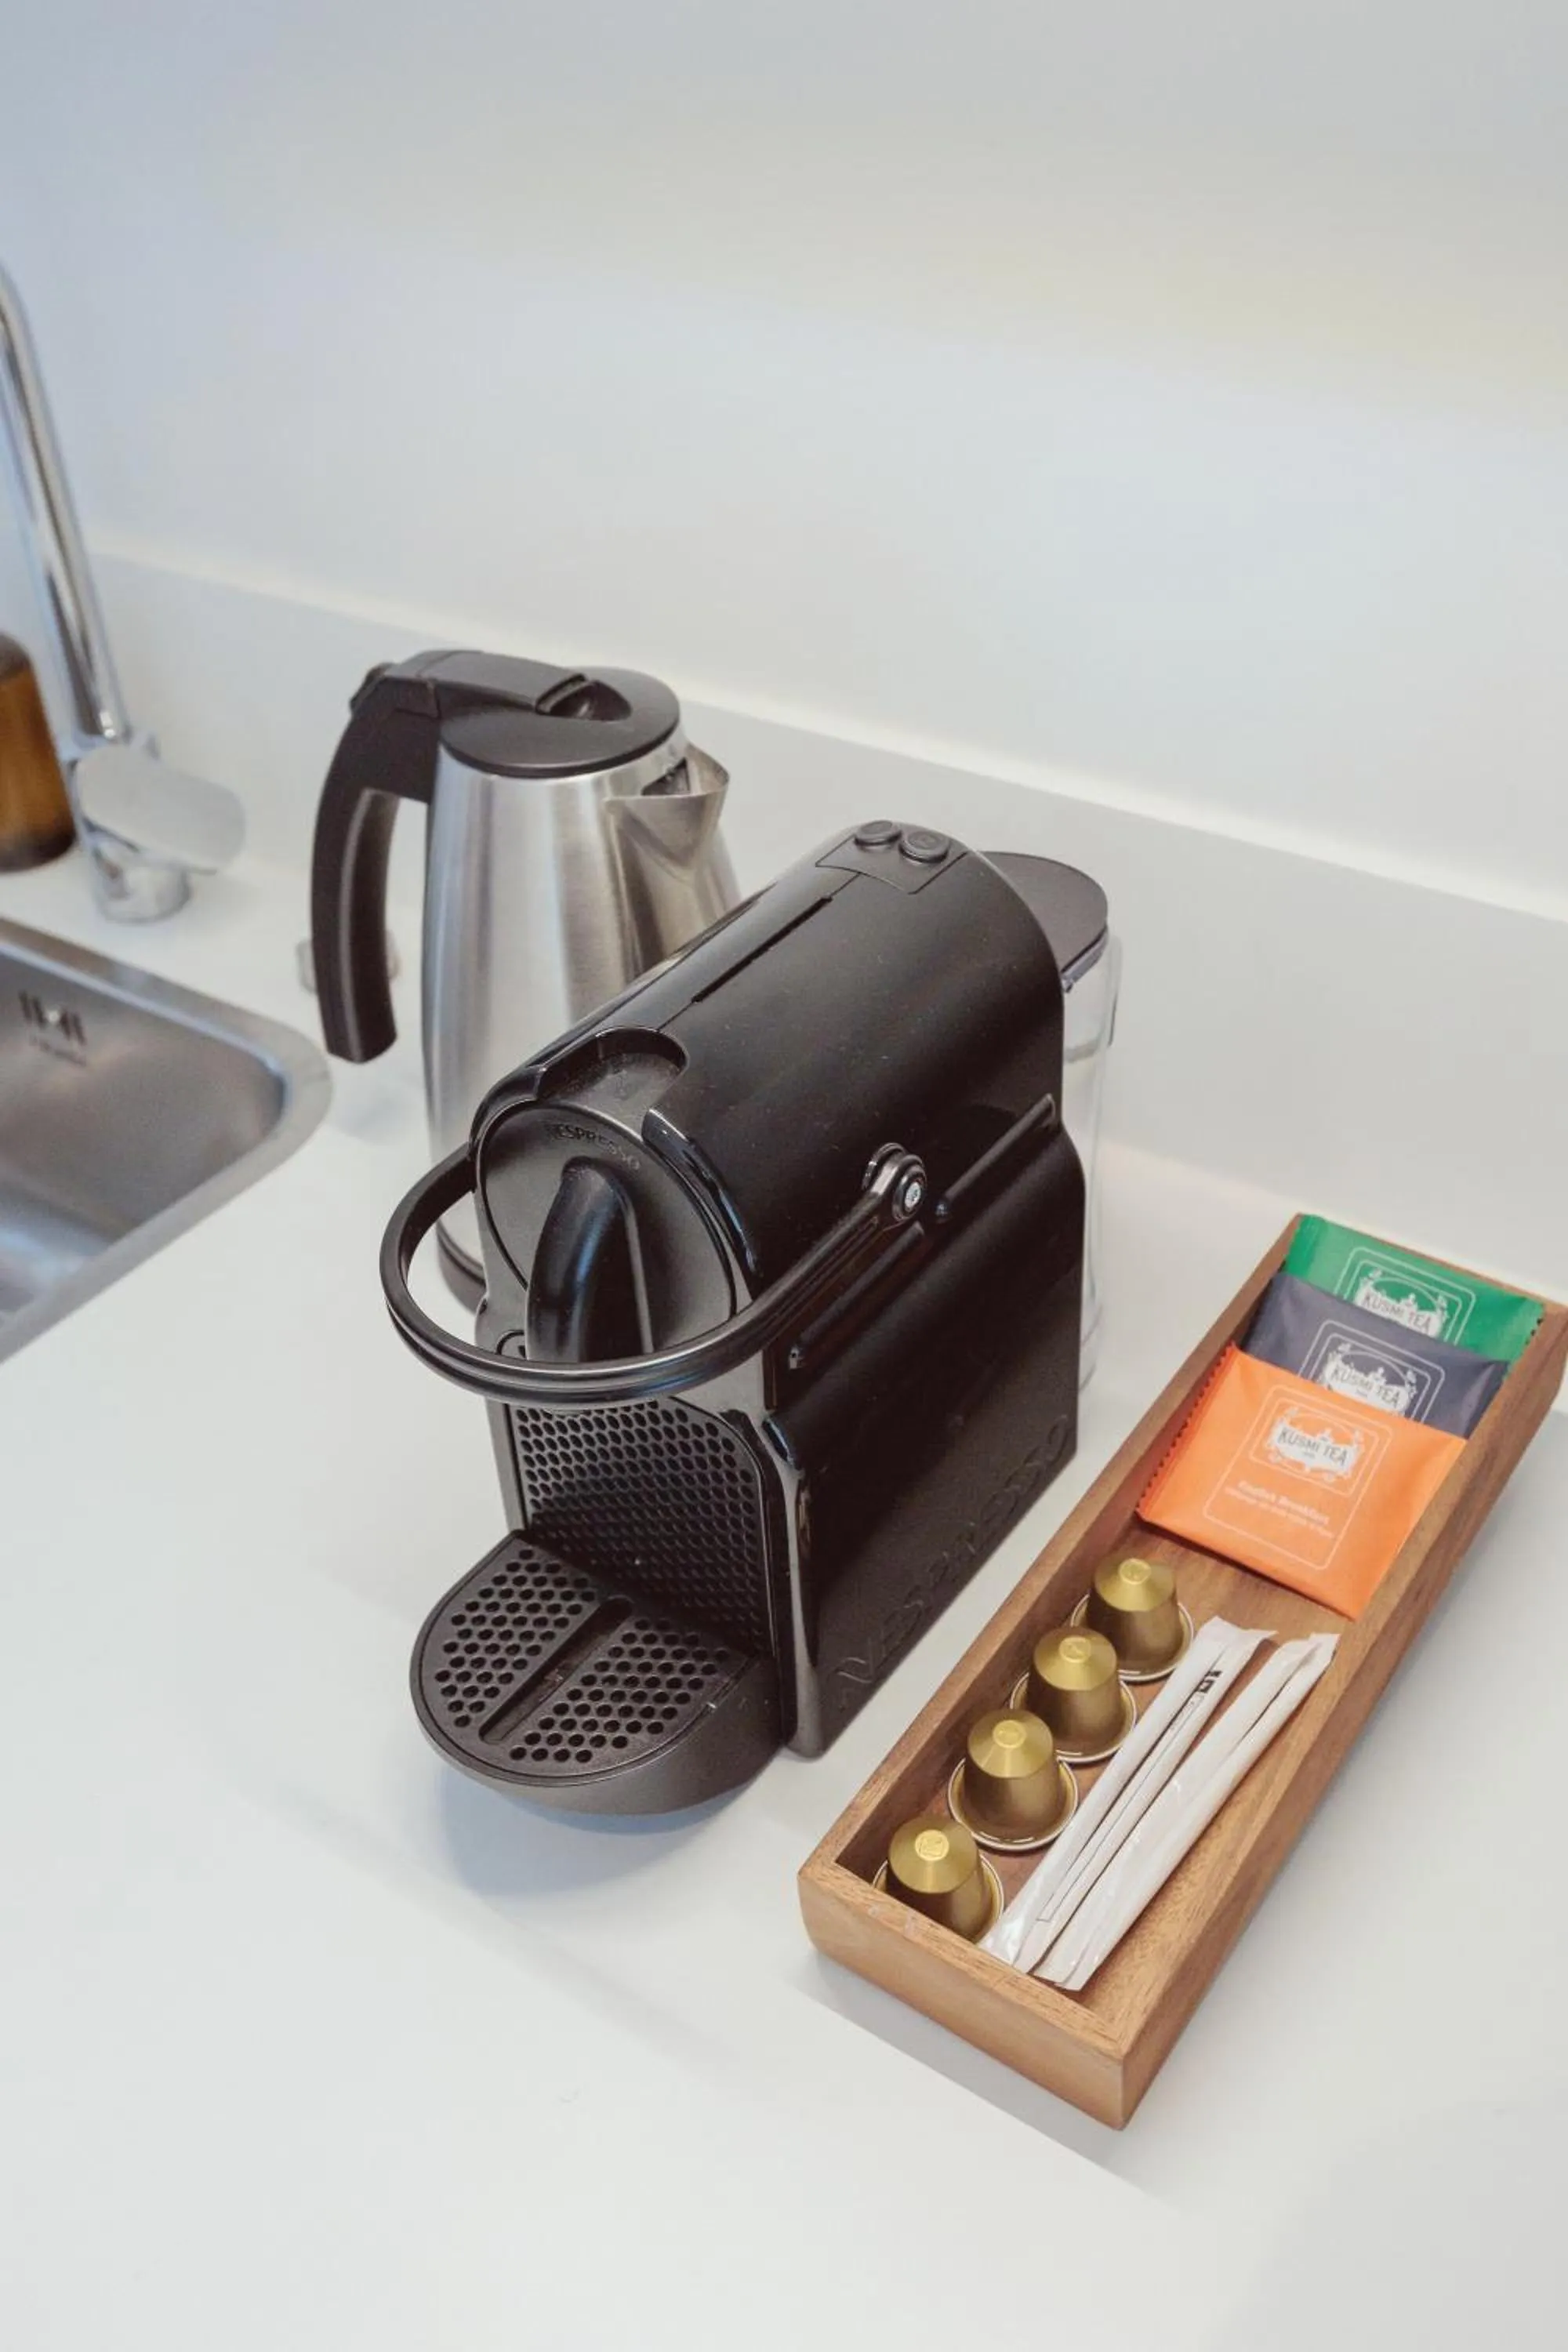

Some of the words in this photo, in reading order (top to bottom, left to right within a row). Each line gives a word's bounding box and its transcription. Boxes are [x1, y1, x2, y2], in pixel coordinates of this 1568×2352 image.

[1363, 1290, 1406, 1318] KUSMI
[1407, 1309, 1432, 1333] TEA
[1331, 1365, 1374, 1392] KUSMI
[1377, 1384, 1402, 1409] TEA
[1277, 1426, 1320, 1452] KUSMI
[1323, 1445, 1348, 1467] TEA
